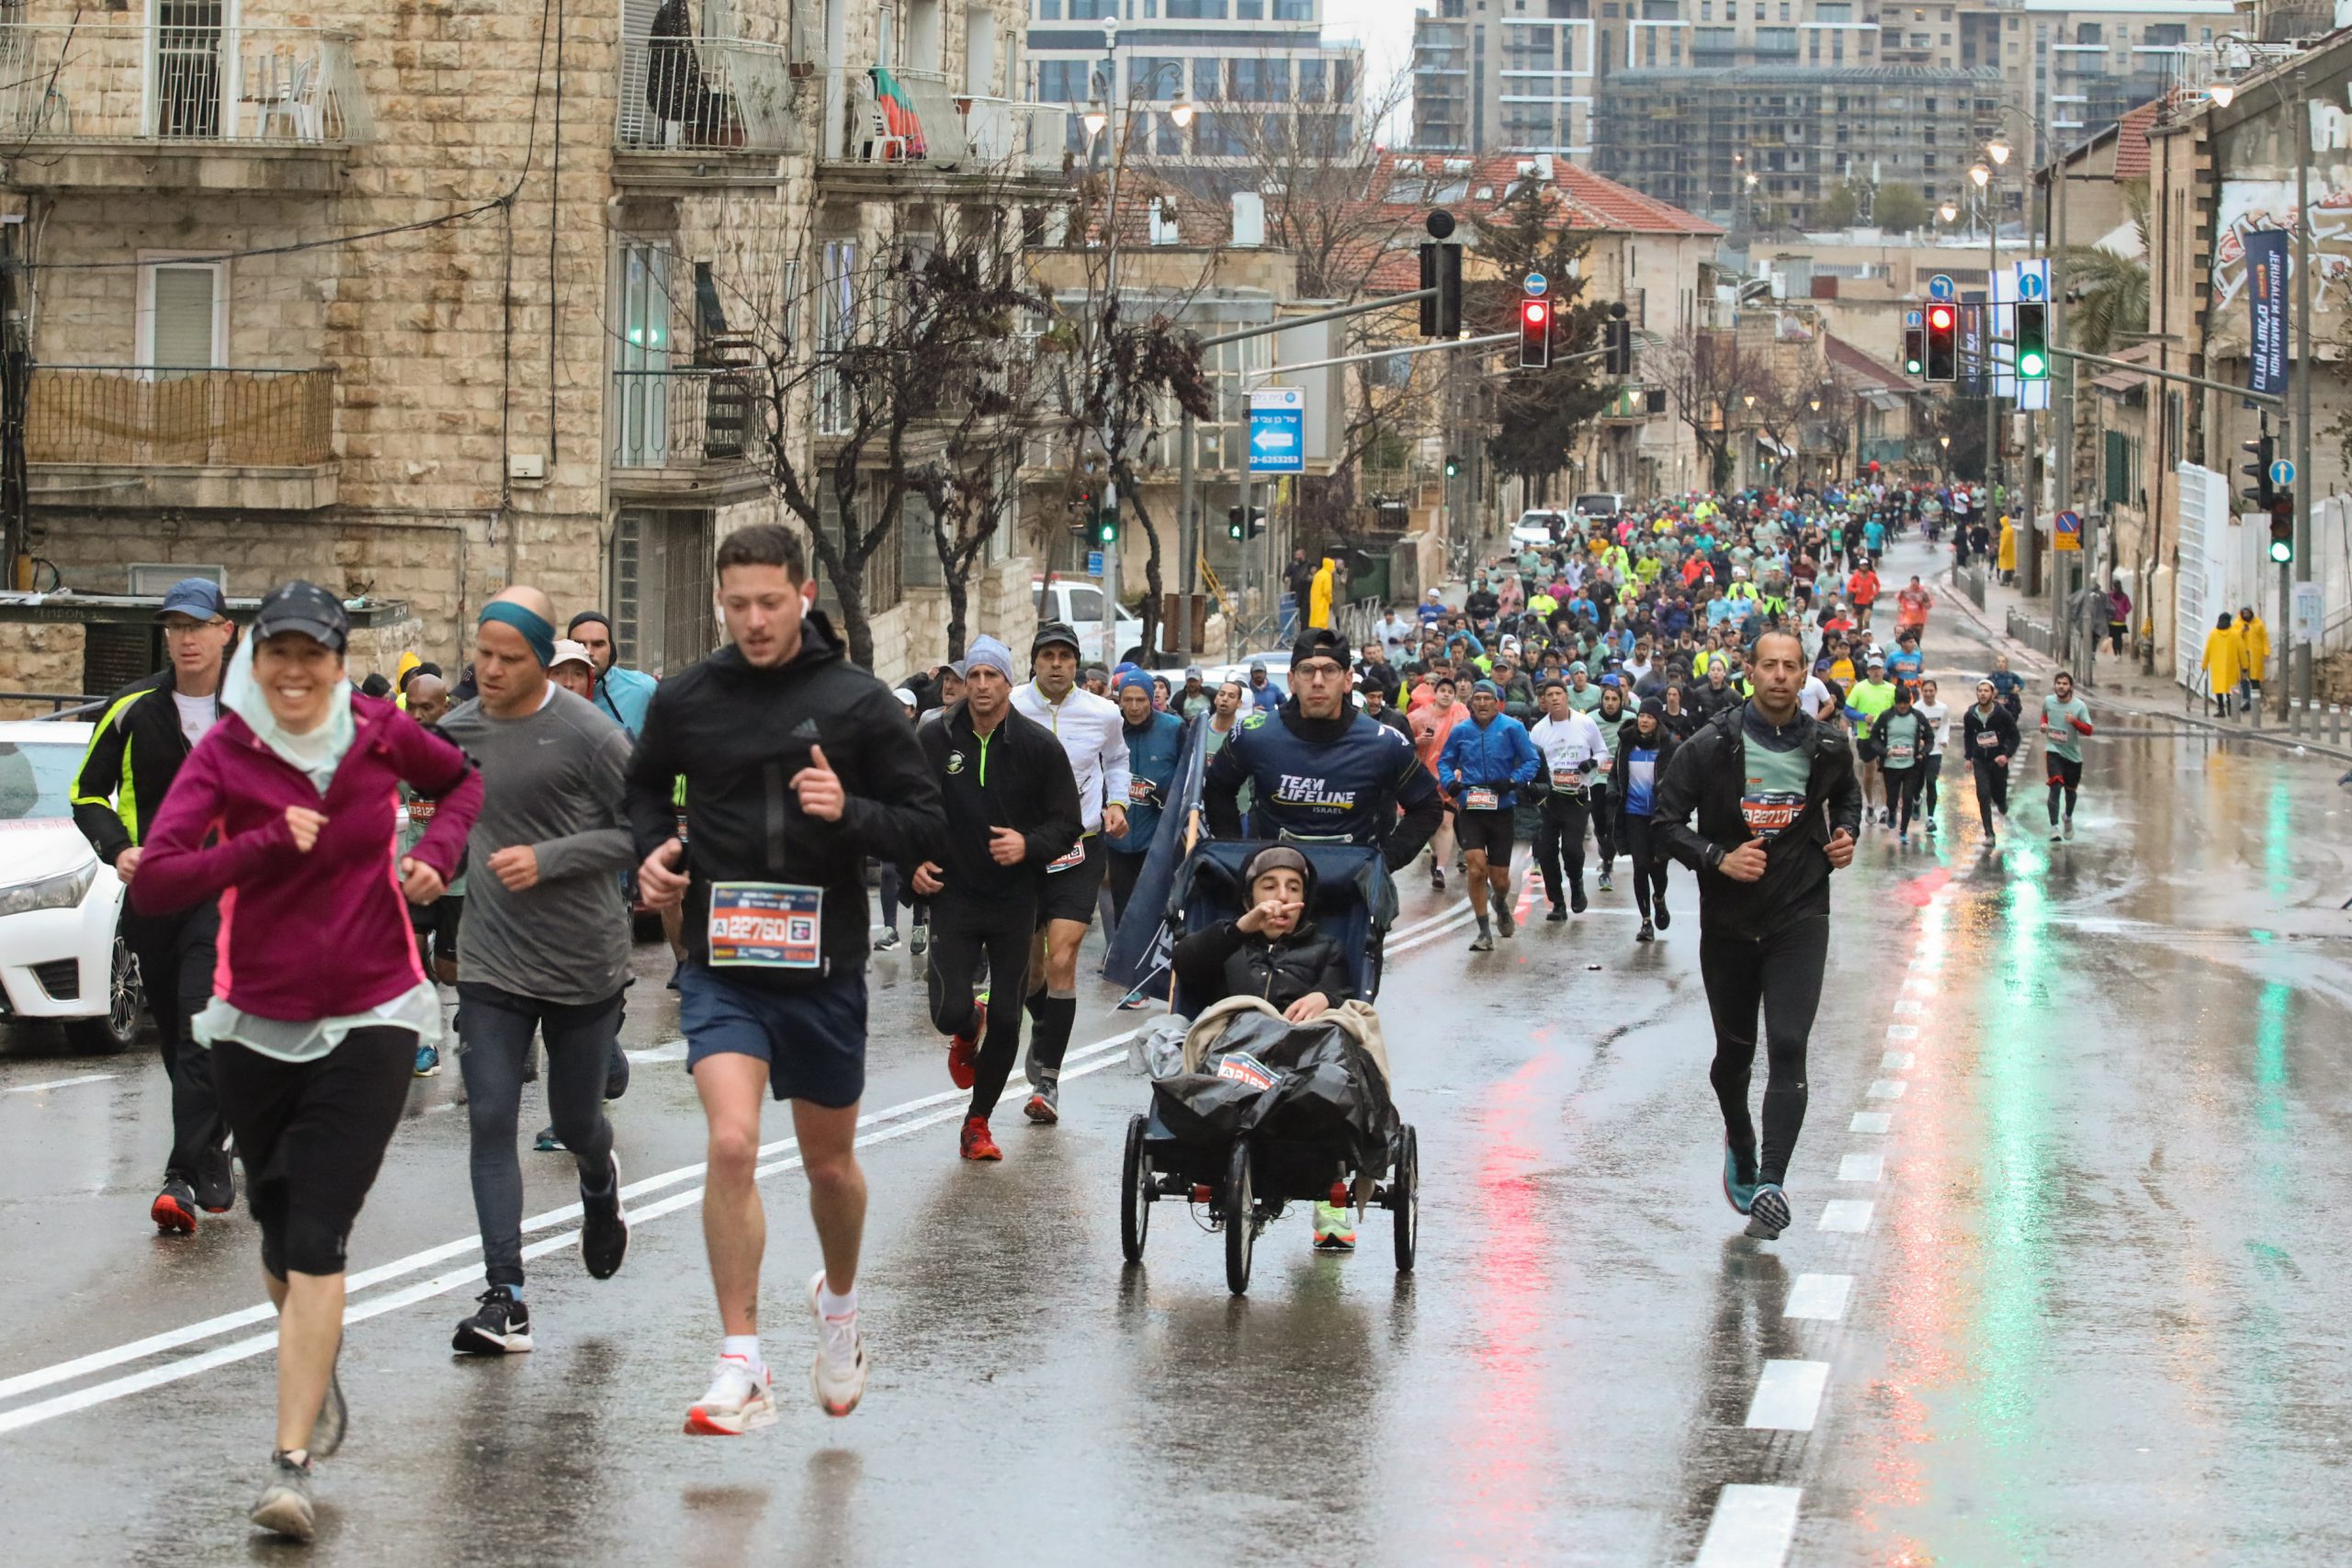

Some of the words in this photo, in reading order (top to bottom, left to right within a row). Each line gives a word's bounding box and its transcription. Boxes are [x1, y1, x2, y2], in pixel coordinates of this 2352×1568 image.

[2269, 250, 2281, 314] JERUSALEM
[2256, 303, 2270, 353] ירושלים
[2270, 316, 2281, 378] MARATHON
[2254, 353, 2267, 390] מרתון
[1278, 787, 1356, 804] LIFELINE
[1280, 774, 1325, 791] TEAM
[1753, 809, 1790, 824] 22717
[715, 921, 724, 934] A
